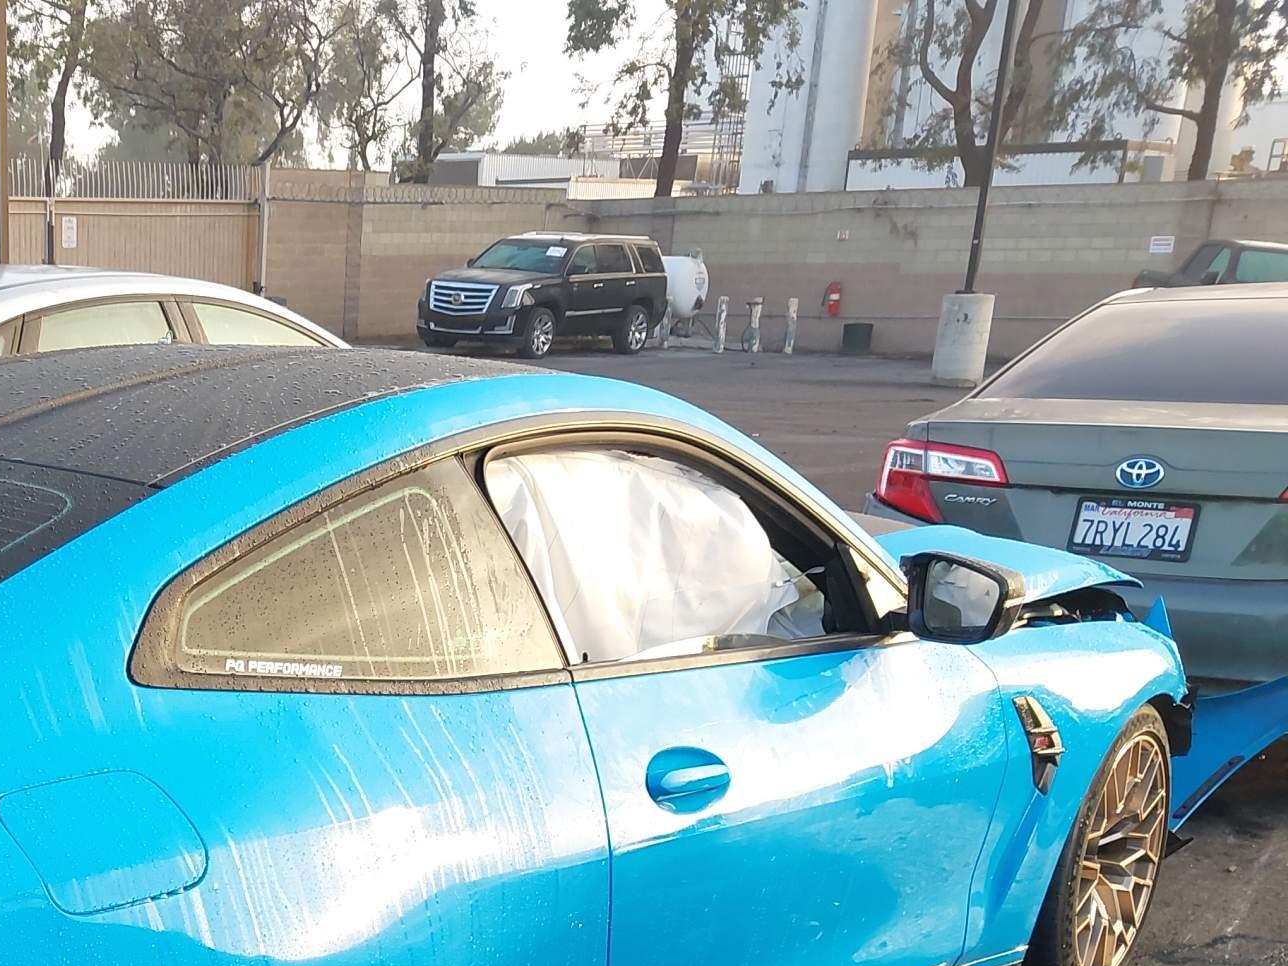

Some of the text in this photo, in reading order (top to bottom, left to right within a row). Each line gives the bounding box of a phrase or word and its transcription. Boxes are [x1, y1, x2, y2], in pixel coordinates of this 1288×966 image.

[1127, 500, 1166, 509] MONTE
[1081, 518, 1182, 551] 7RYL284
[247, 660, 344, 678] PERFORMANCE
